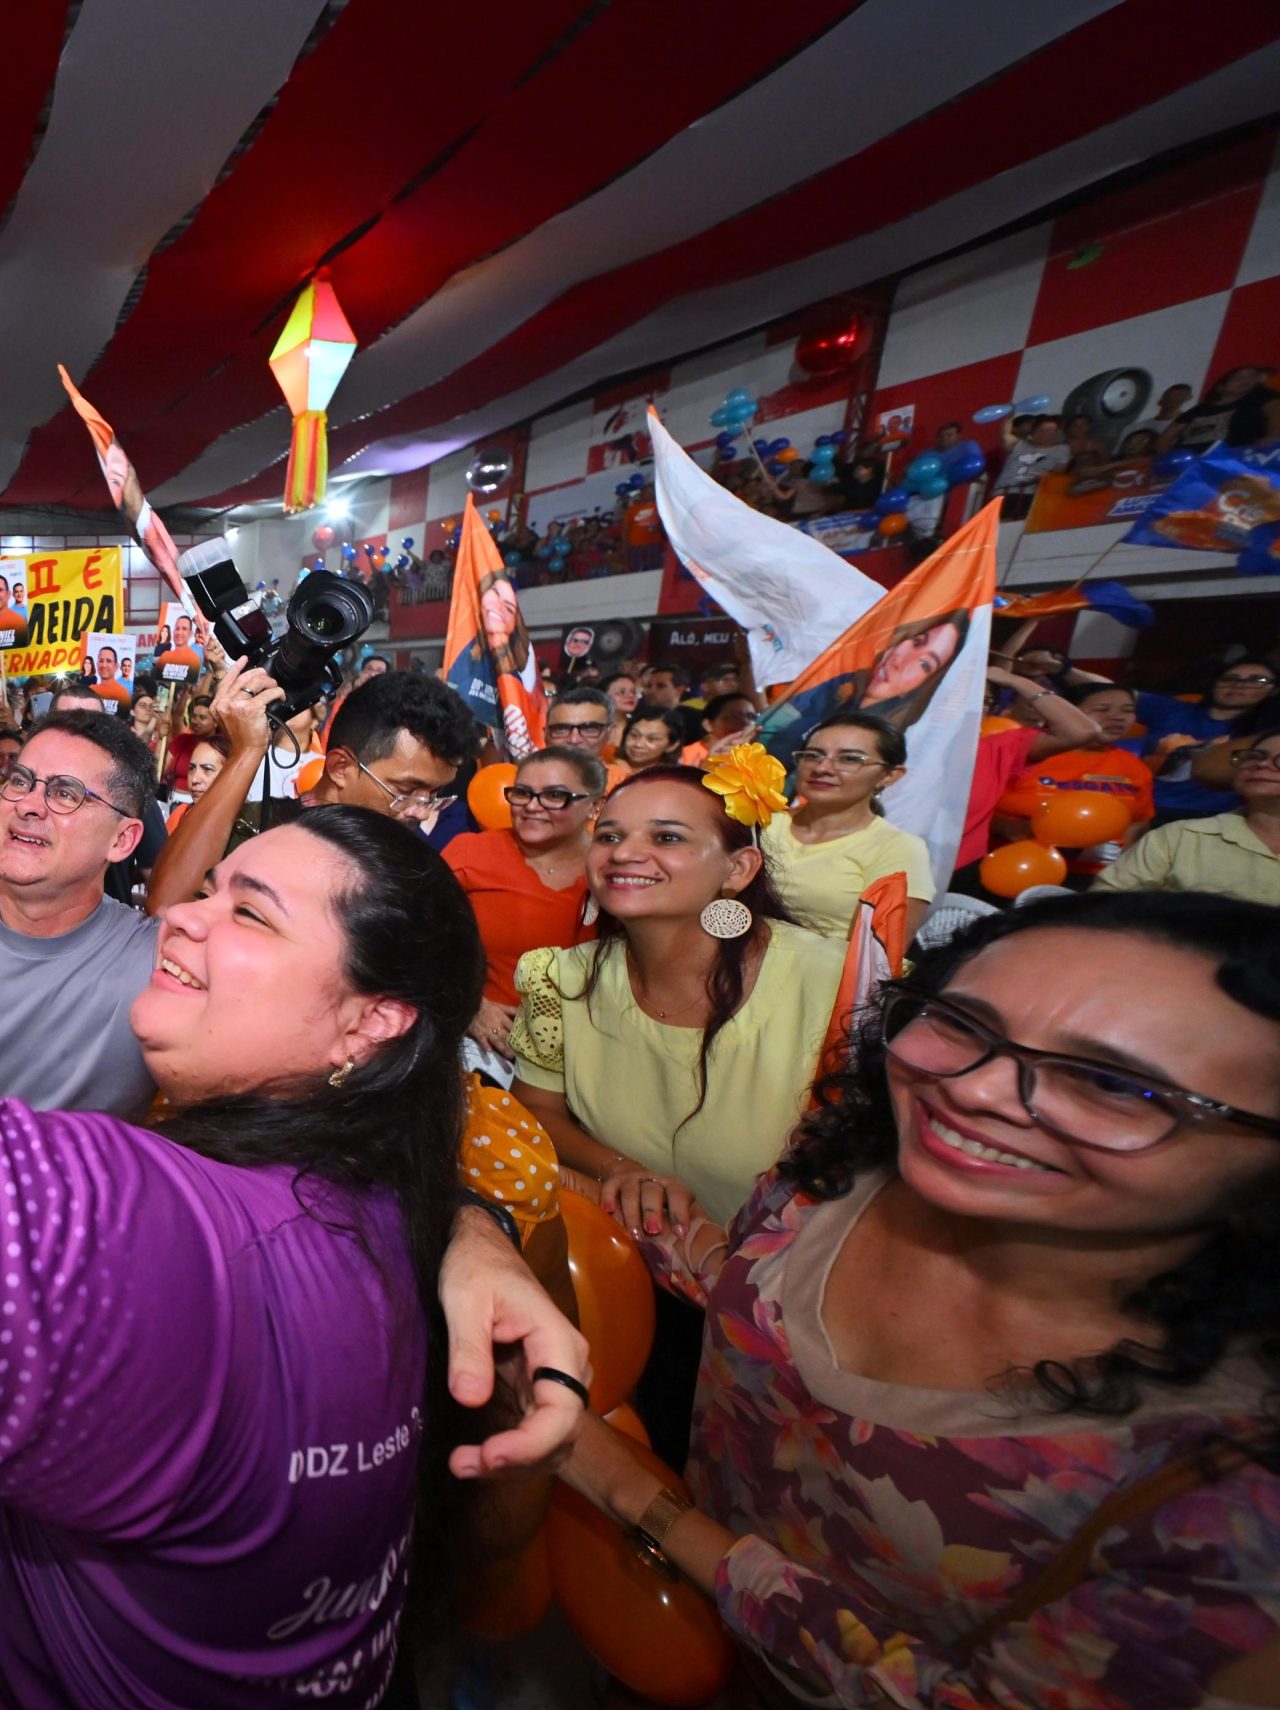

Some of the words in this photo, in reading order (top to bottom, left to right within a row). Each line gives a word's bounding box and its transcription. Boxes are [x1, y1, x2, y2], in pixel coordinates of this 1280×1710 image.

[27, 559, 61, 599] II
[83, 550, 104, 590] É
[357, 1424, 410, 1473] Leste
